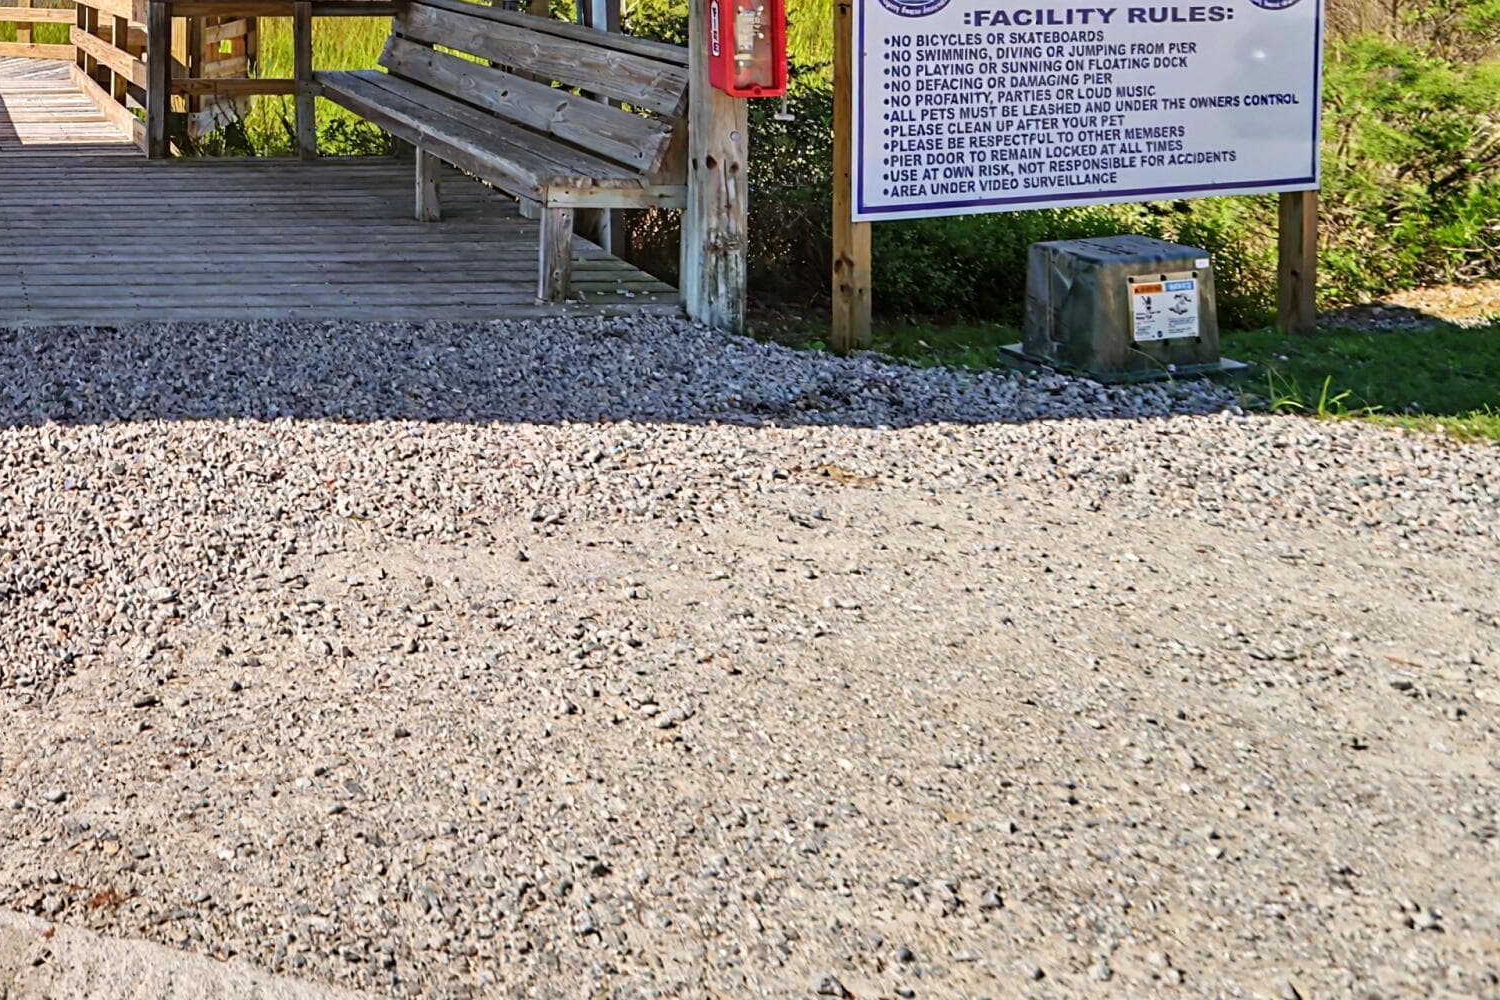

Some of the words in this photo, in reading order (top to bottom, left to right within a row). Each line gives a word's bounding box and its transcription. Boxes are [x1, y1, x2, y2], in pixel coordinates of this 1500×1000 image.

[1128, 6, 1234, 24] RULES:
[916, 34, 982, 46] BICYCLES
[986, 32, 1005, 44] OR
[1009, 30, 1104, 44] SKATEBOARDS
[916, 48, 992, 62] SWIMMING,
[996, 46, 1042, 60] DIVING
[1046, 46, 1064, 58] OR
[1068, 44, 1126, 57] JUMPING
[1130, 43, 1164, 54] FROM
[1169, 42, 1196, 54] PIER
[916, 63, 974, 76] PLAYING
[979, 62, 997, 74] OR
[1001, 60, 1062, 74] SUNNING
[1066, 60, 1084, 71] ON
[1088, 58, 1150, 70] FLOATING
[1154, 56, 1188, 68] DOCK
[916, 78, 983, 91] DEFACING
[988, 77, 1006, 89] OR
[1010, 74, 1079, 88] DAMAGING
[1084, 73, 1112, 85] PIER
[916, 92, 994, 106] PROFANITY,
[998, 89, 1052, 103] PARTIES
[1056, 88, 1074, 100] OR
[1078, 88, 1112, 100] LOUD
[1116, 86, 1156, 98] MUSIC
[920, 108, 955, 121] PETS
[960, 106, 996, 119] MUST
[1002, 105, 1018, 117] BE
[1022, 102, 1081, 116] LEASHED
[1084, 100, 1111, 113] AND
[1115, 99, 1158, 112] UNDER
[1162, 98, 1186, 110] THE
[1189, 95, 1240, 108] OWNERS
[1244, 94, 1300, 106] CONTROL
[948, 121, 992, 135] CLEAN
[996, 120, 1014, 132] UP
[1016, 118, 1058, 131] AFTER
[1062, 116, 1097, 128] YOUR
[1101, 114, 1125, 127] PET
[948, 137, 964, 149] BE
[970, 133, 1054, 148] RESPECTFUL
[1057, 132, 1074, 143] TO
[1080, 128, 1120, 142] OTHER
[1124, 126, 1185, 140] MEMBERS
[926, 152, 965, 165] DOOR
[969, 151, 986, 162] TO
[991, 148, 1042, 162] REMAIN
[1046, 144, 1097, 158] LOCKED
[1100, 144, 1116, 156] AT
[1120, 142, 1142, 154] ALL
[1146, 140, 1183, 152] TIMES
[922, 168, 939, 181] AT
[943, 166, 974, 179] OWN
[978, 164, 1014, 177] RISK,
[1018, 162, 1044, 174] NOT
[1050, 157, 1136, 172] RESPONSIBLE
[1140, 154, 1164, 168] FOR
[1168, 151, 1236, 165] ACCIDENTS
[931, 181, 976, 195] UNDER
[979, 178, 1019, 192] VIDEO
[1023, 172, 1117, 189] SURVEILLANCE
